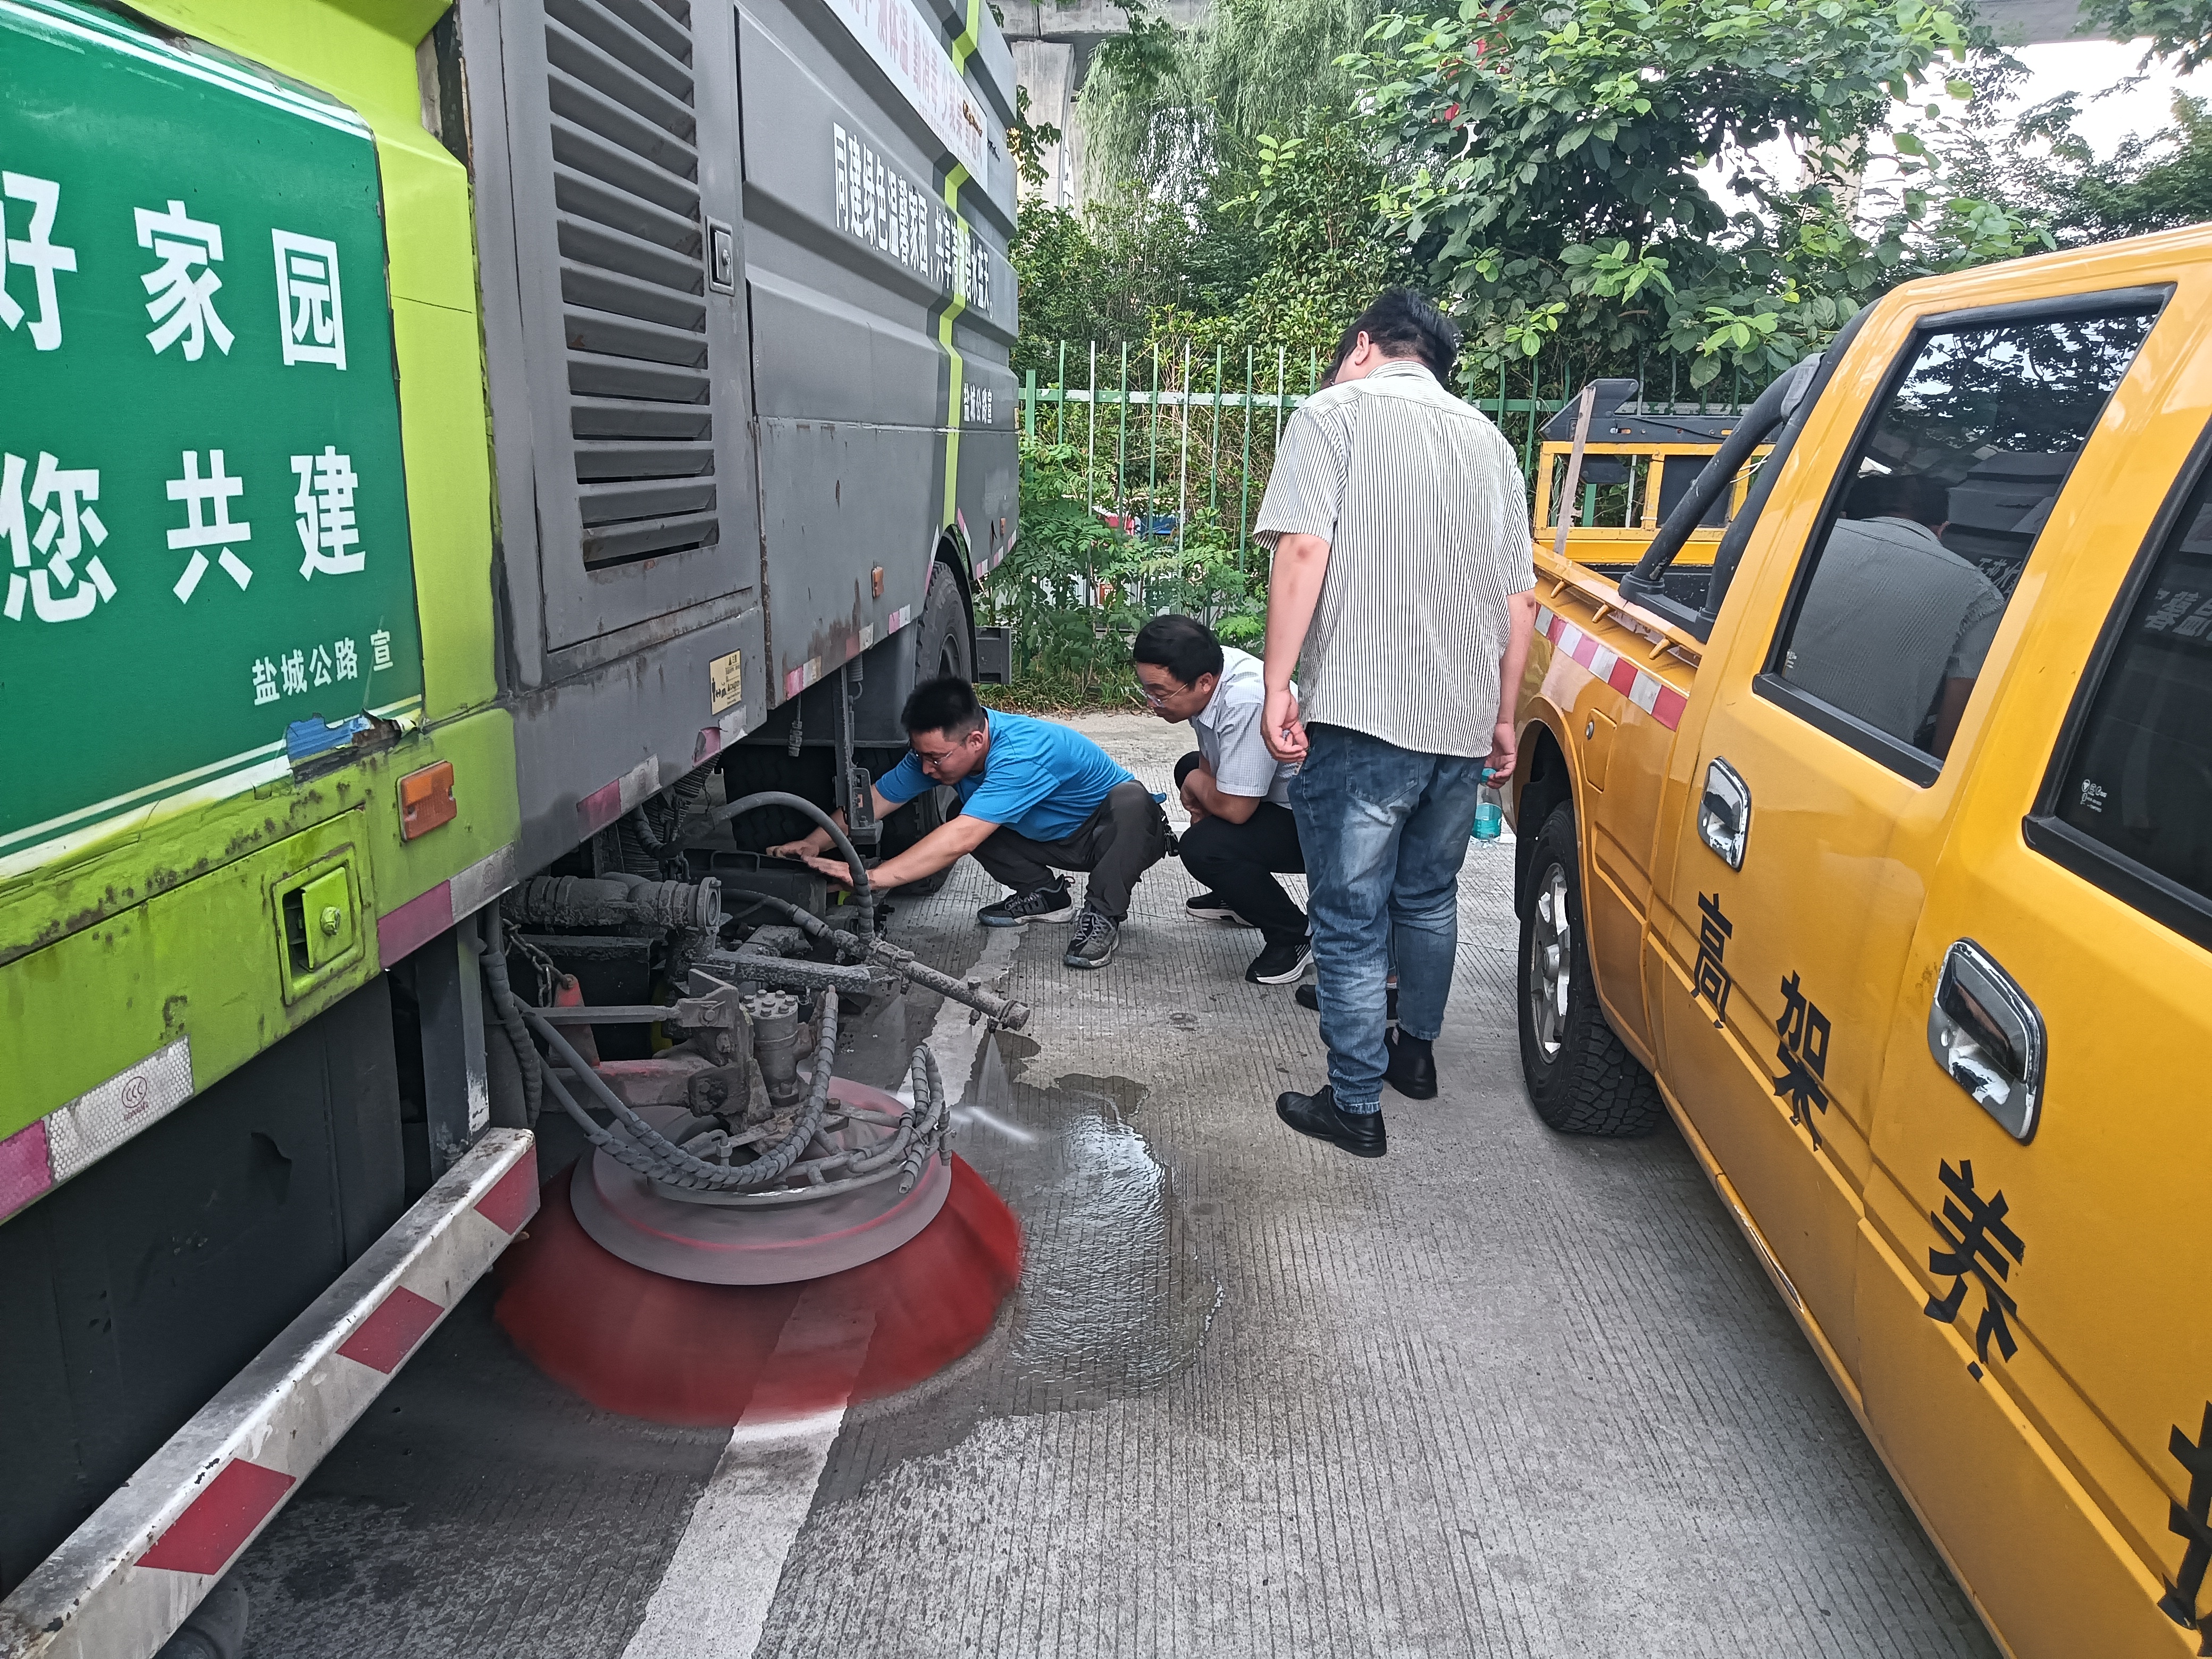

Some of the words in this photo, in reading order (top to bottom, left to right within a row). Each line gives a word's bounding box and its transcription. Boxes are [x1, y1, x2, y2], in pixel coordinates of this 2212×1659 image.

[0, 171, 347, 371] 好家园
[0, 445, 366, 623] 您共建
[252, 637, 358, 706] 盐城公路
[370, 629, 393, 672] 宣
